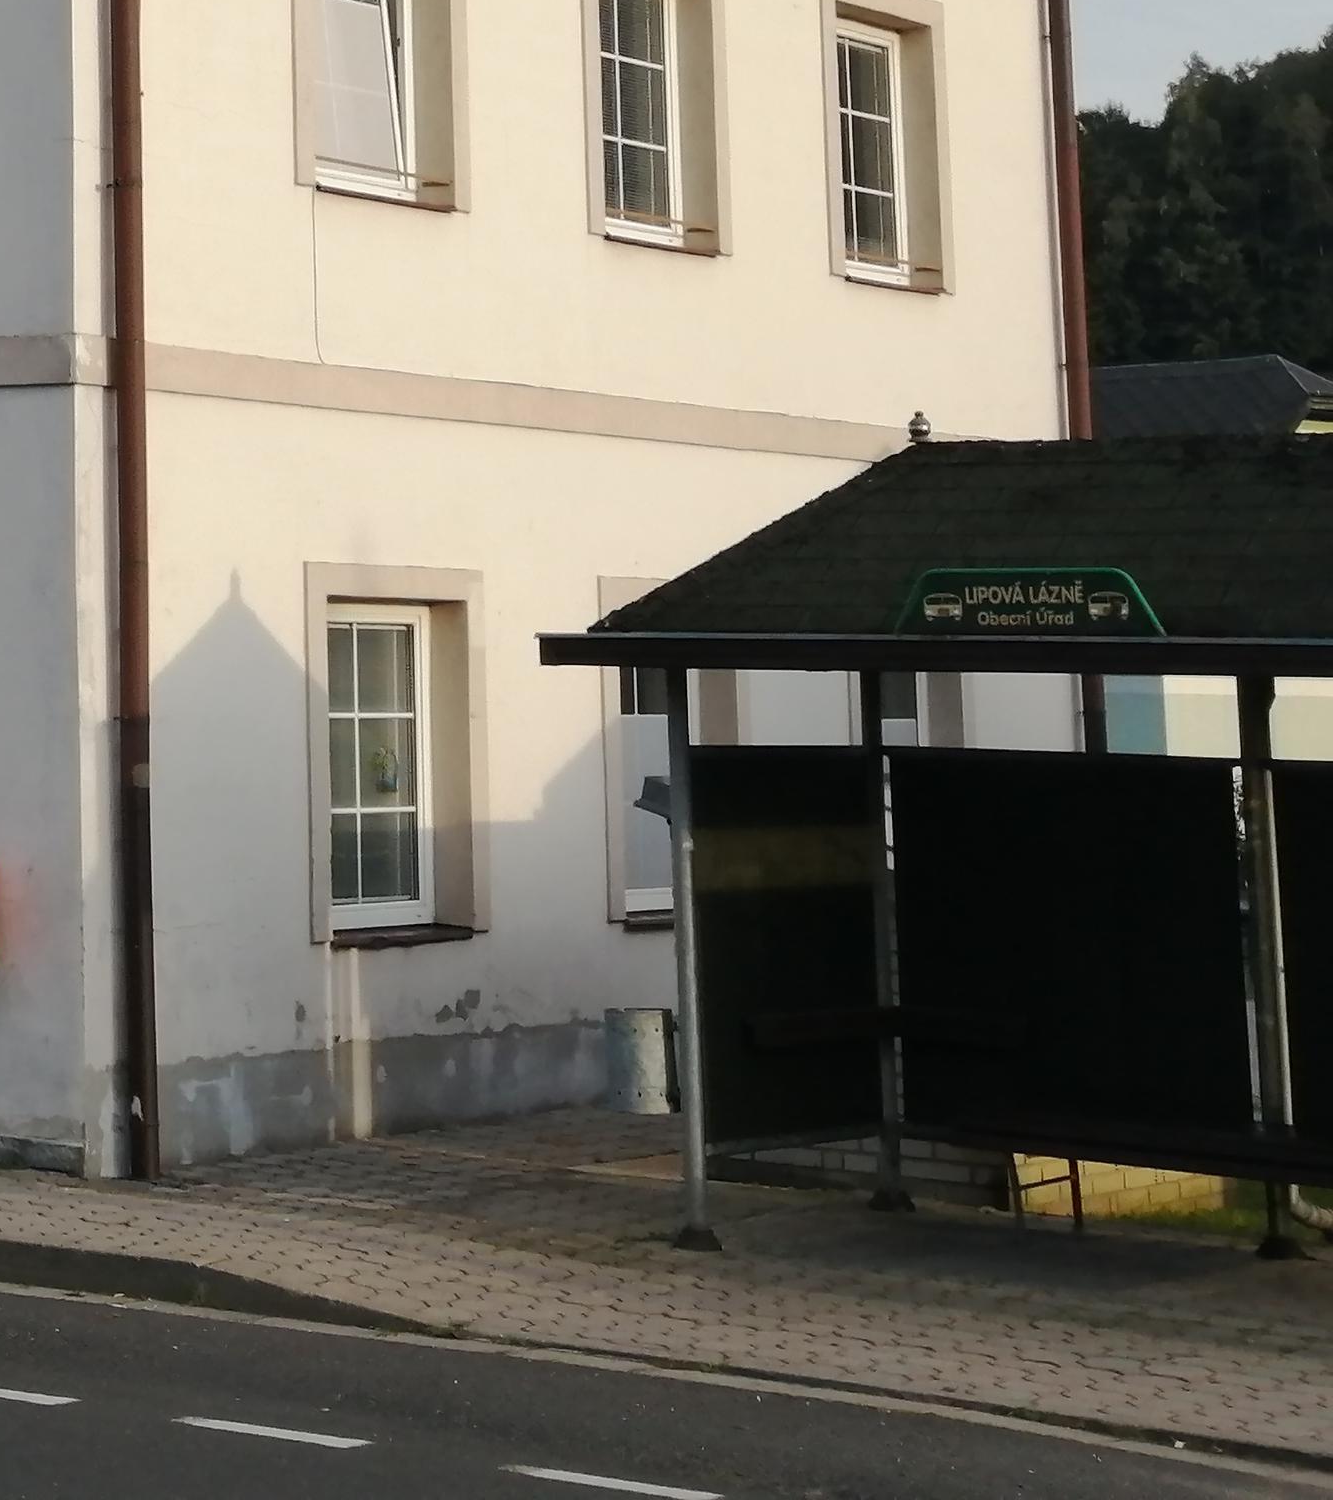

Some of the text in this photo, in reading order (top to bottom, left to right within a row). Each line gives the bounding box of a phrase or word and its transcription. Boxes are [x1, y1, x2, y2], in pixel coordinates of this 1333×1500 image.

[964, 580, 1085, 604] LIPOVÁ LÁZNĚ
[977, 606, 1075, 626] Obecní Úřad
